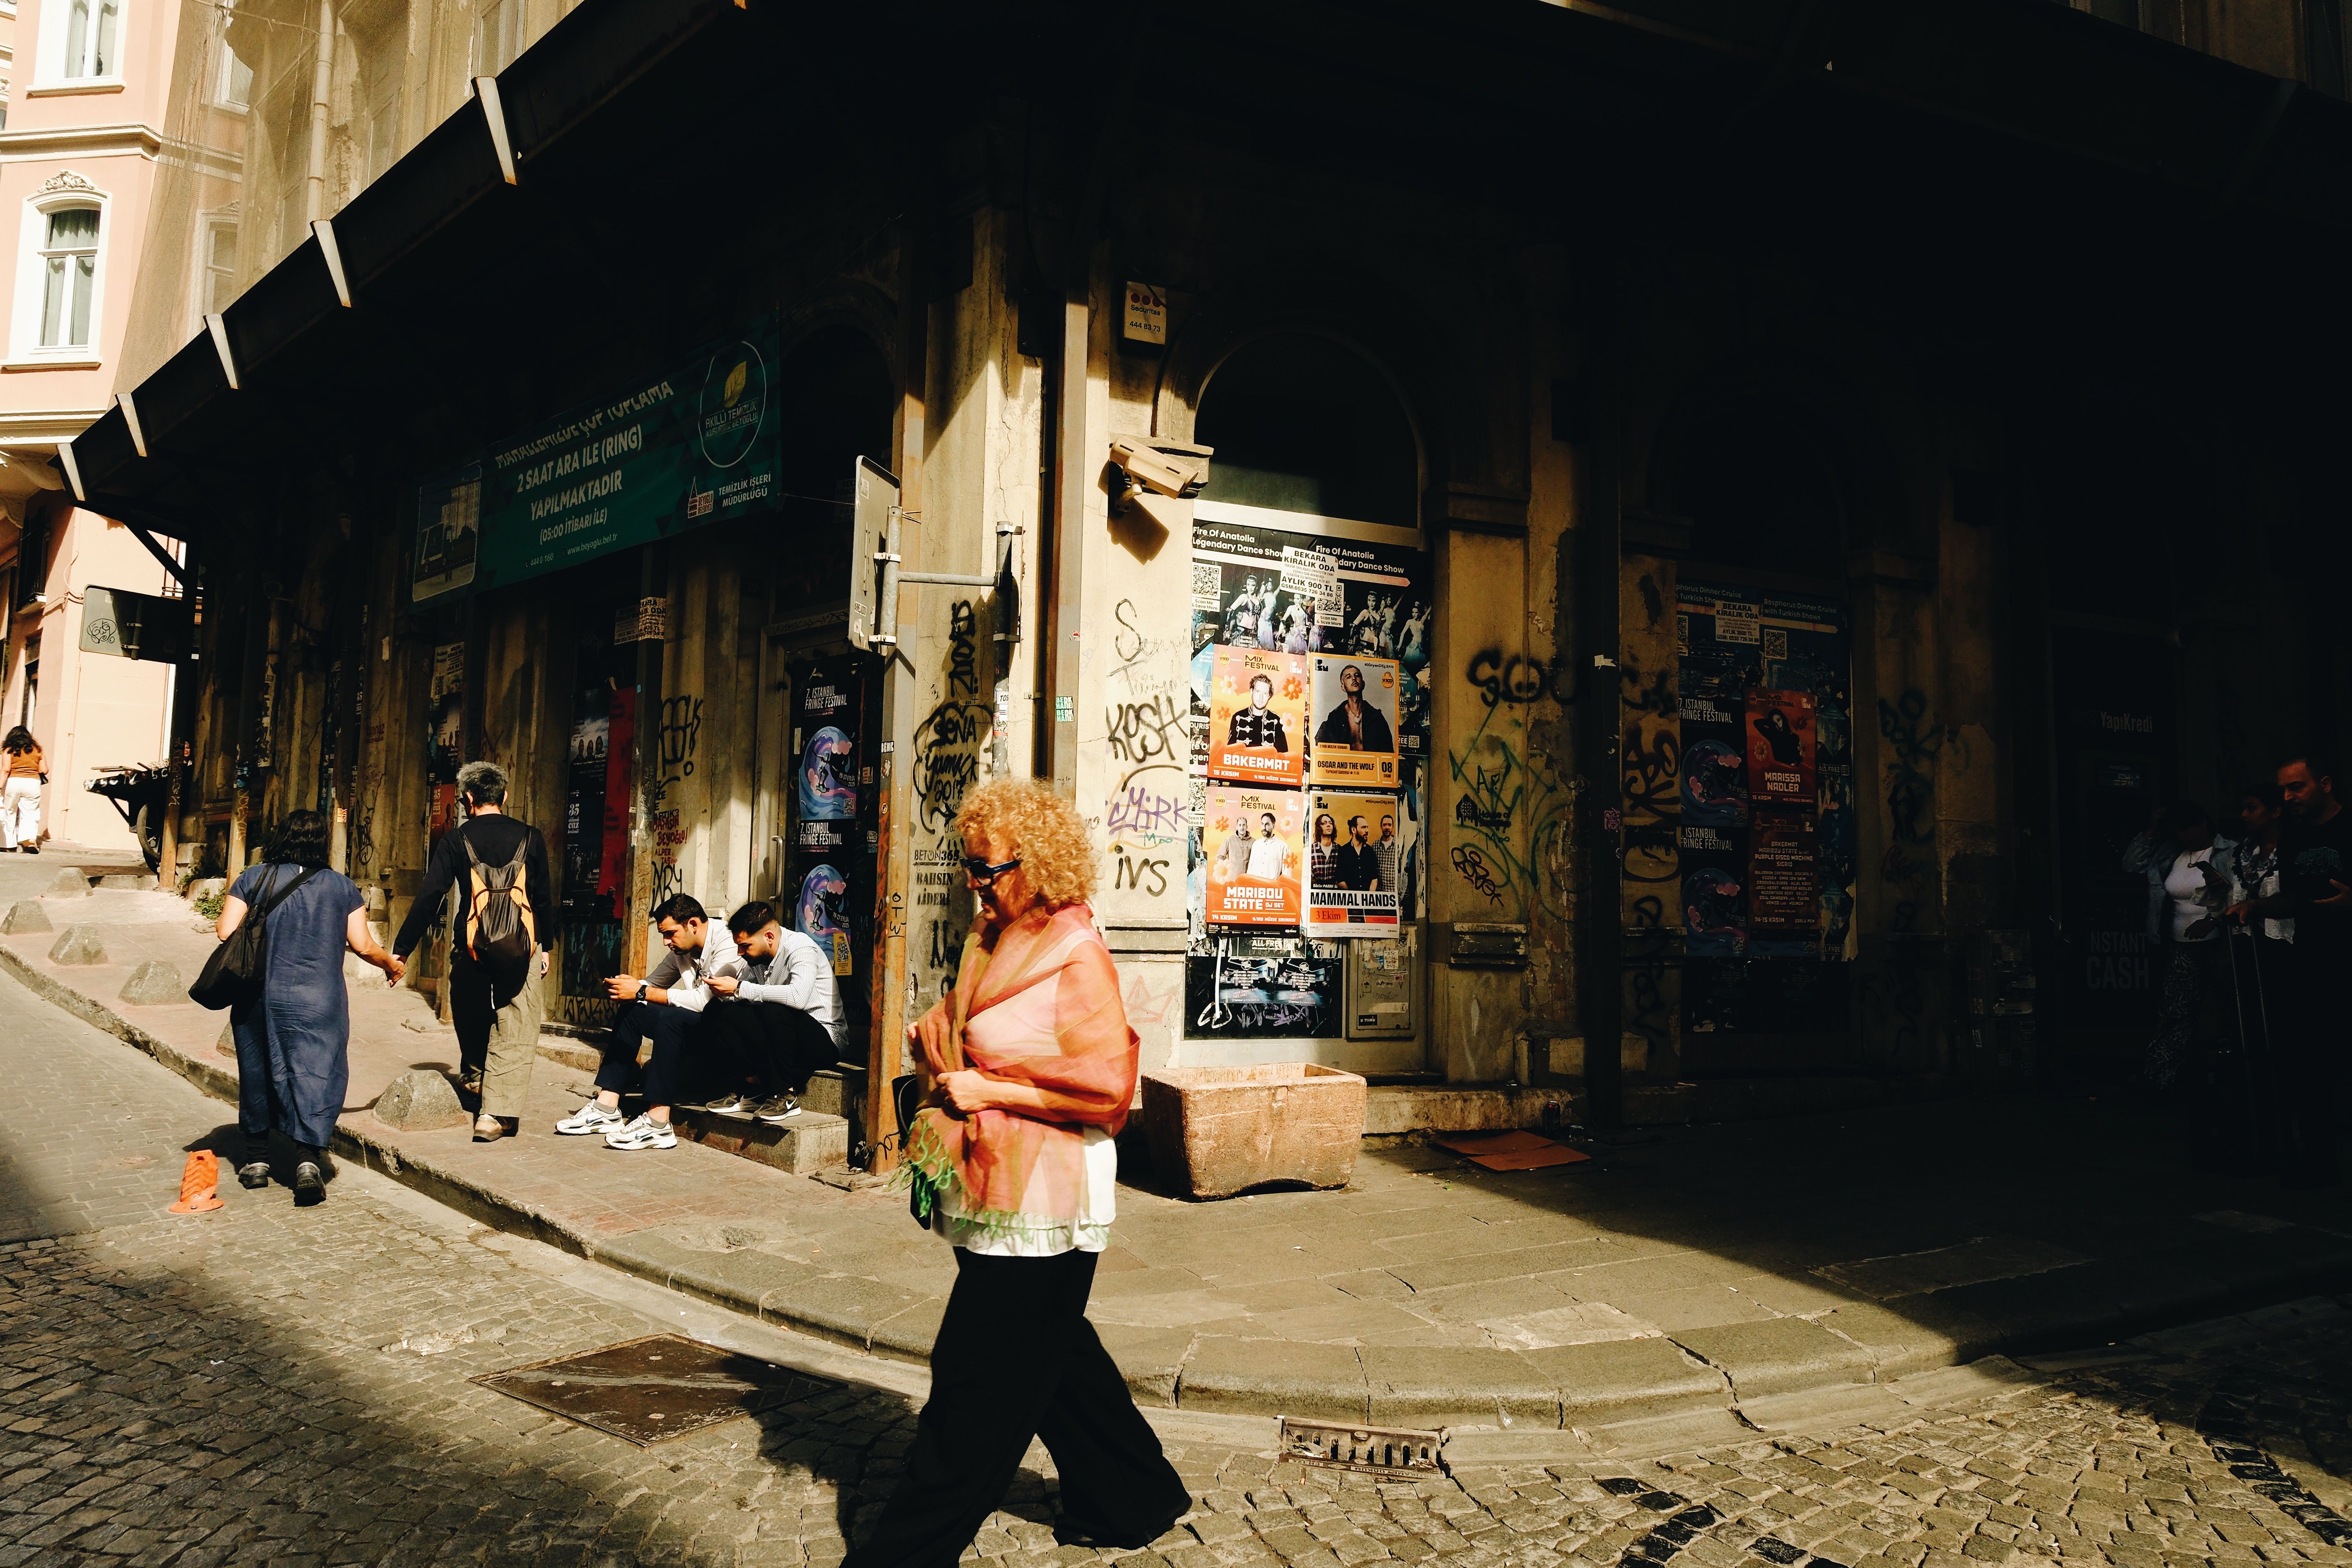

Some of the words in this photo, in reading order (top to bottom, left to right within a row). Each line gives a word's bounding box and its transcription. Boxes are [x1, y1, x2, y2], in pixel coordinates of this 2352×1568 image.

[1131, 305, 1161, 316] Securitas
[706, 412, 726, 429] AKILLI
[517, 473, 524, 493] 2
[525, 460, 554, 490] SAAT
[555, 450, 580, 478] ARA
[602, 423, 642, 464] (RİNG)
[718, 478, 747, 496] TEMİZLİK
[749, 471, 771, 487] İŞLERİ
[530, 469, 623, 521] YAPILMAKTADIR
[698, 492, 714, 506] BEYOĞLU
[723, 486, 767, 508] MÜDÜRLÜĞÜ
[540, 519, 564, 545] (05:00
[564, 513, 593, 535] İTİBARI
[593, 507, 608, 525] İLE)
[1193, 526, 1208, 536] Fire
[1209, 529, 1219, 537] Of
[1220, 531, 1255, 543] Anatolia
[567, 533, 618, 556] www.beyoglu.bel.tr
[1193, 537, 1236, 552] Legendary
[1237, 544, 1263, 555] Dance
[1294, 551, 1326, 563] BEKARA
[1316, 545, 1330, 554] Fire
[1342, 549, 1375, 560] Anatolia
[539, 556, 544, 565] 0
[544, 553, 554, 562] 160
[1284, 556, 1316, 568] KİRALIK
[1319, 564, 1335, 573] ODA
[1358, 561, 1383, 571] Dance
[1384, 565, 1404, 574] Show
[1282, 576, 1306, 586] AYLIK
[1281, 583, 1307, 592] GSM:0535
[1700, 587, 1720, 596] Dinner
[1680, 593, 1703, 602] Turkish
[1723, 603, 1752, 612] BEKARA
[1764, 599, 1796, 608] Bosphorus
[1797, 603, 1817, 611] Dinner
[1716, 608, 1743, 618] KİRALIK
[1745, 611, 1759, 620] ODA
[1779, 609, 1801, 617] Turkish
[1245, 662, 1280, 671] FESTIVAL
[812, 685, 835, 698] ISTANBUL
[805, 697, 824, 710] FRINGE
[825, 694, 847, 707] FESTIVAL
[1678, 698, 1683, 708] 7.
[1686, 699, 1715, 711] ISTANBUL
[1679, 709, 1701, 721] FRINGE
[1703, 711, 1733, 723] FESTIVAL
[2100, 710, 2153, 733] YapıKredi
[1223, 753, 1290, 771] BAKERMAT
[1318, 760, 1336, 769] OSCAR
[1381, 761, 1392, 773] 08
[1765, 772, 1801, 783] MARISSA
[1767, 782, 1799, 792] NADLER
[569, 804, 580, 816] 35
[1241, 802, 1276, 810] FESTIVAL
[806, 822, 830, 834] ISTANBUL
[1686, 827, 1717, 839] ISTANBUL
[800, 834, 818, 845] FRINGE
[819, 833, 842, 845] FESTIVAL
[1705, 839, 1733, 850] FESTIVAL
[1227, 886, 1283, 899] MARIBOU
[1224, 898, 1263, 910] STATE
[1311, 892, 1359, 906] MAMMAL
[1361, 894, 1396, 907] HANDS
[1316, 911, 1320, 919] 3
[1322, 911, 1341, 920] Ekim
[2090, 931, 2147, 953] NSTANT
[2087, 956, 2149, 989] CASH
